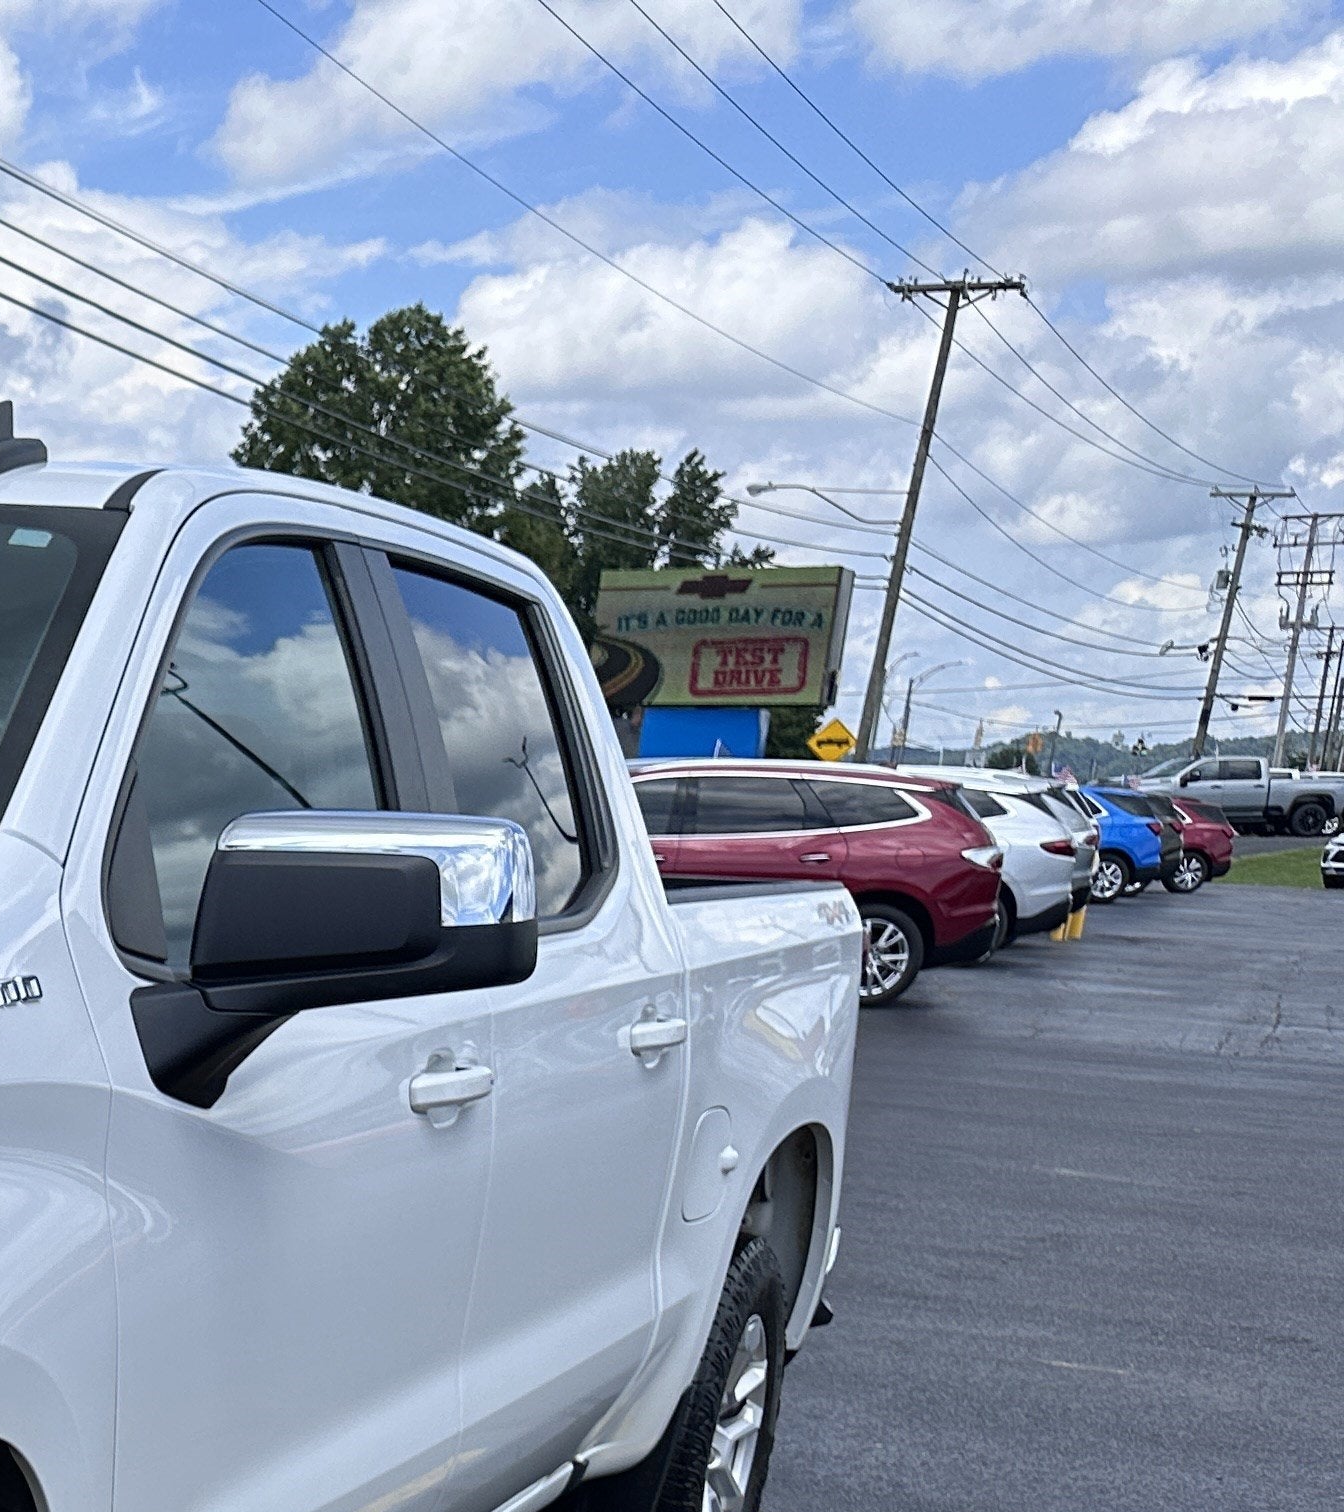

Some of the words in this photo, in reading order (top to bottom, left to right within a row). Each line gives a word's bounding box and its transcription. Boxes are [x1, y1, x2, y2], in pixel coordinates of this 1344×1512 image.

[617, 612, 649, 632] IT'S
[655, 610, 668, 627] A
[675, 606, 721, 625] GOOD
[728, 606, 764, 625] DAY
[770, 606, 807, 627] FOR
[810, 609, 825, 629] A
[716, 645, 785, 667] TEST
[713, 668, 784, 687] DRIVE
